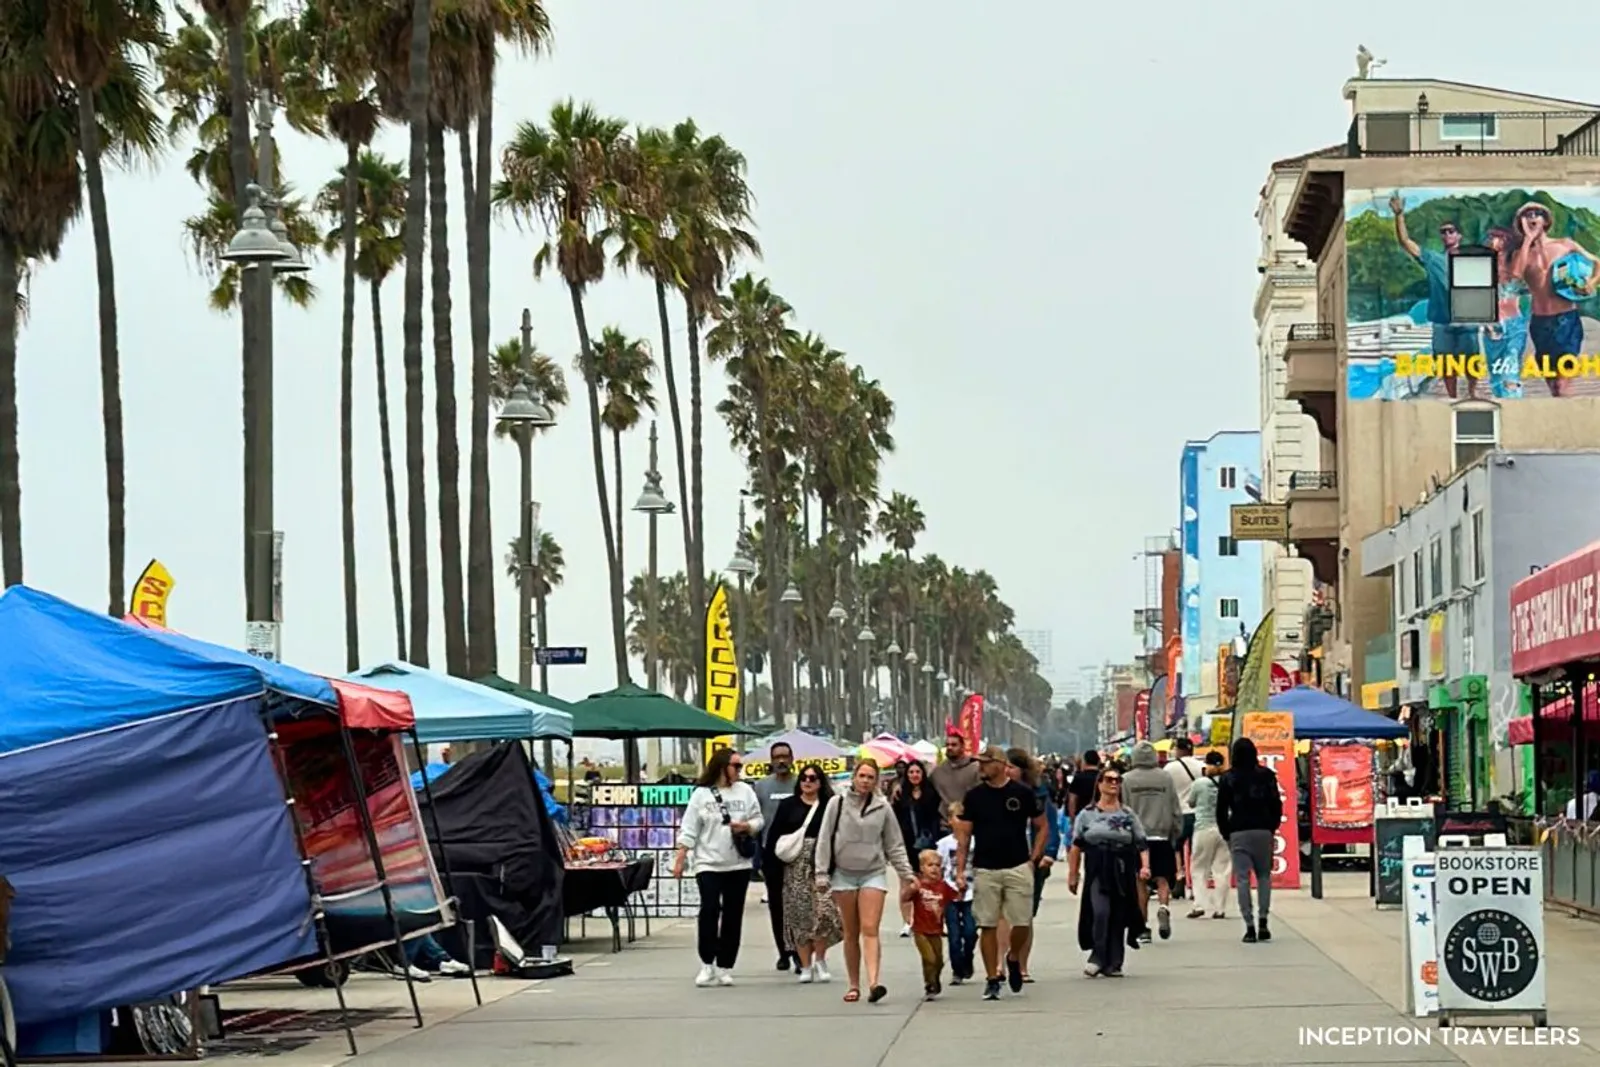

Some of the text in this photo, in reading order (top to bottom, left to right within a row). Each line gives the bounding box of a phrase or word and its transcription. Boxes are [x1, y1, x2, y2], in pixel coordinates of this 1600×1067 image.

[1395, 353, 1487, 378] BRING
[1491, 358, 1520, 375] the
[745, 758, 840, 777] CARATURES
[592, 785, 638, 805] HENNA
[1439, 856, 1539, 870] BOOKSTORE
[1448, 877, 1531, 895] OPEN
[1470, 911, 1510, 922] WORLD
